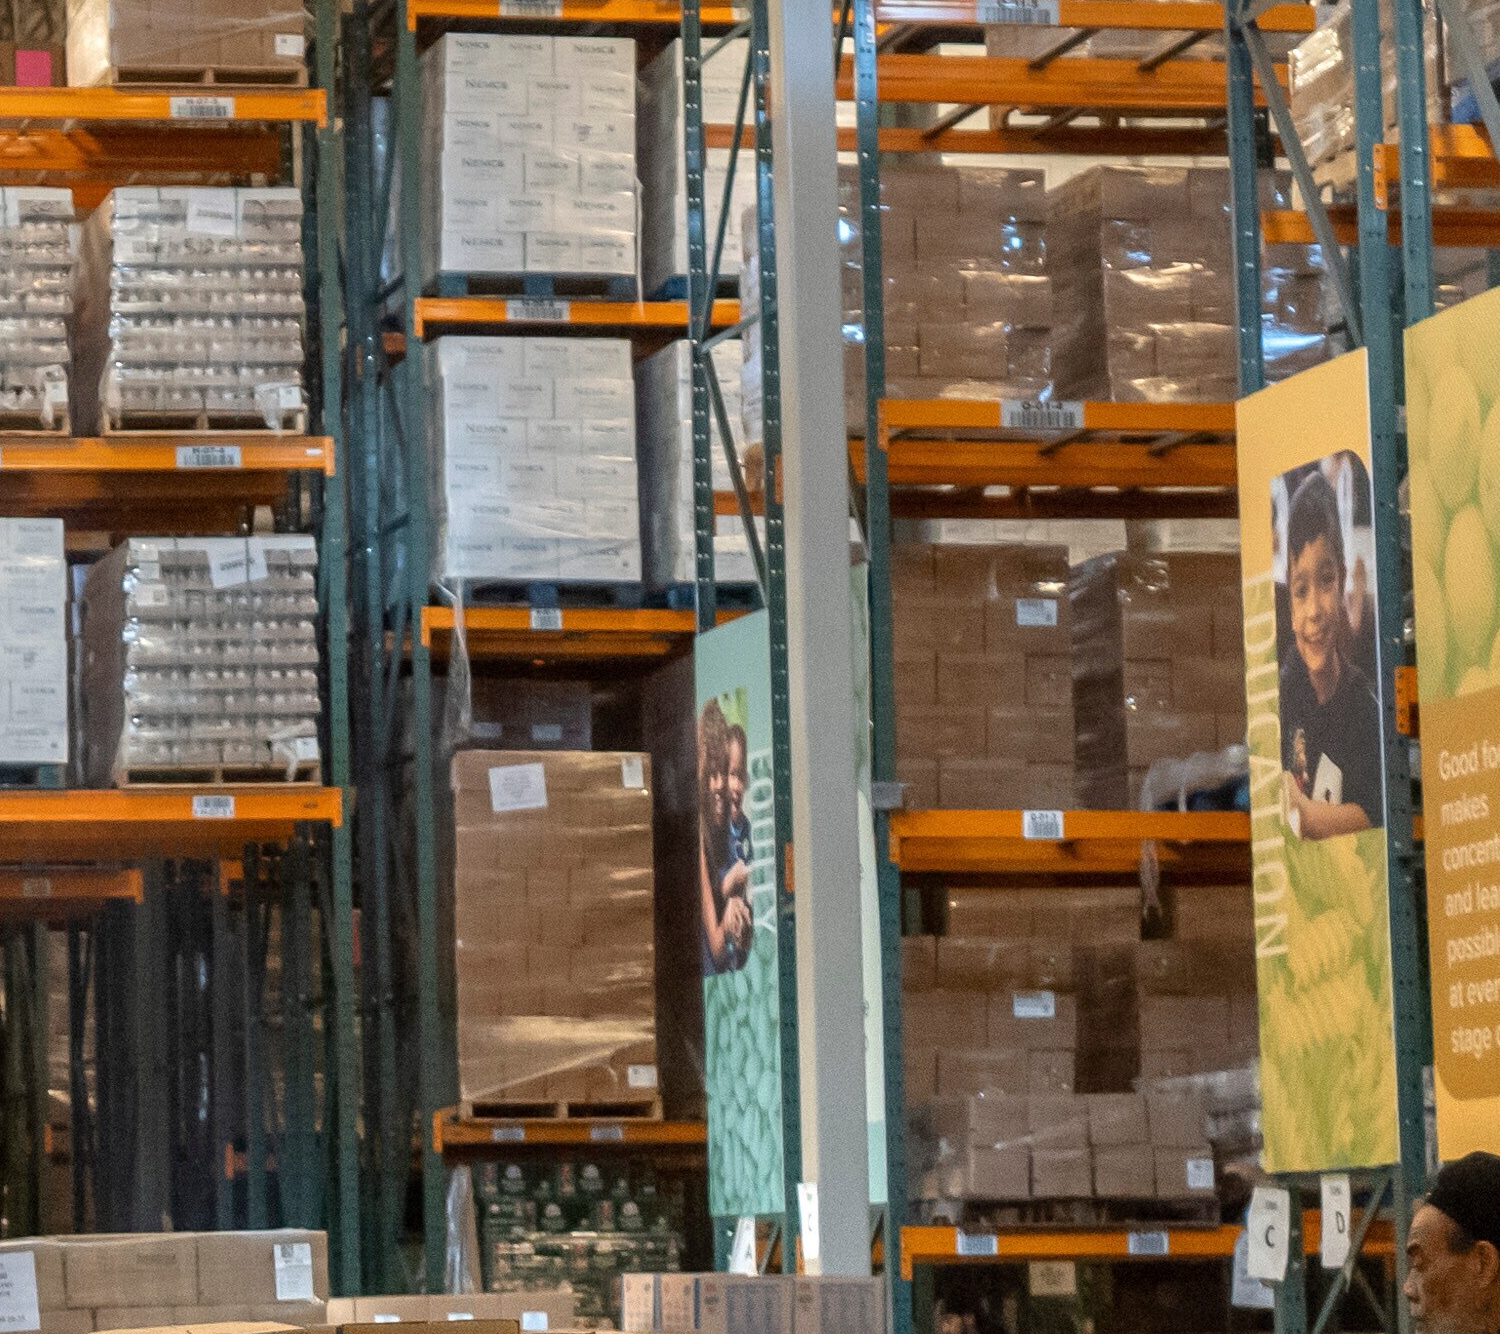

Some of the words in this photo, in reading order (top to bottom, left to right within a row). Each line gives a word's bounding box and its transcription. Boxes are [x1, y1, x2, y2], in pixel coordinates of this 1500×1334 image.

[1243, 573, 1290, 959] EDUCATION
[1438, 746, 1479, 780] Good
[1440, 792, 1490, 826] makes
[1445, 888, 1473, 918] and
[1449, 982, 1465, 1009] at
[1451, 1022, 1493, 1059] stage
[1264, 1224, 1275, 1249] C
[1335, 1210, 1346, 1234] D
